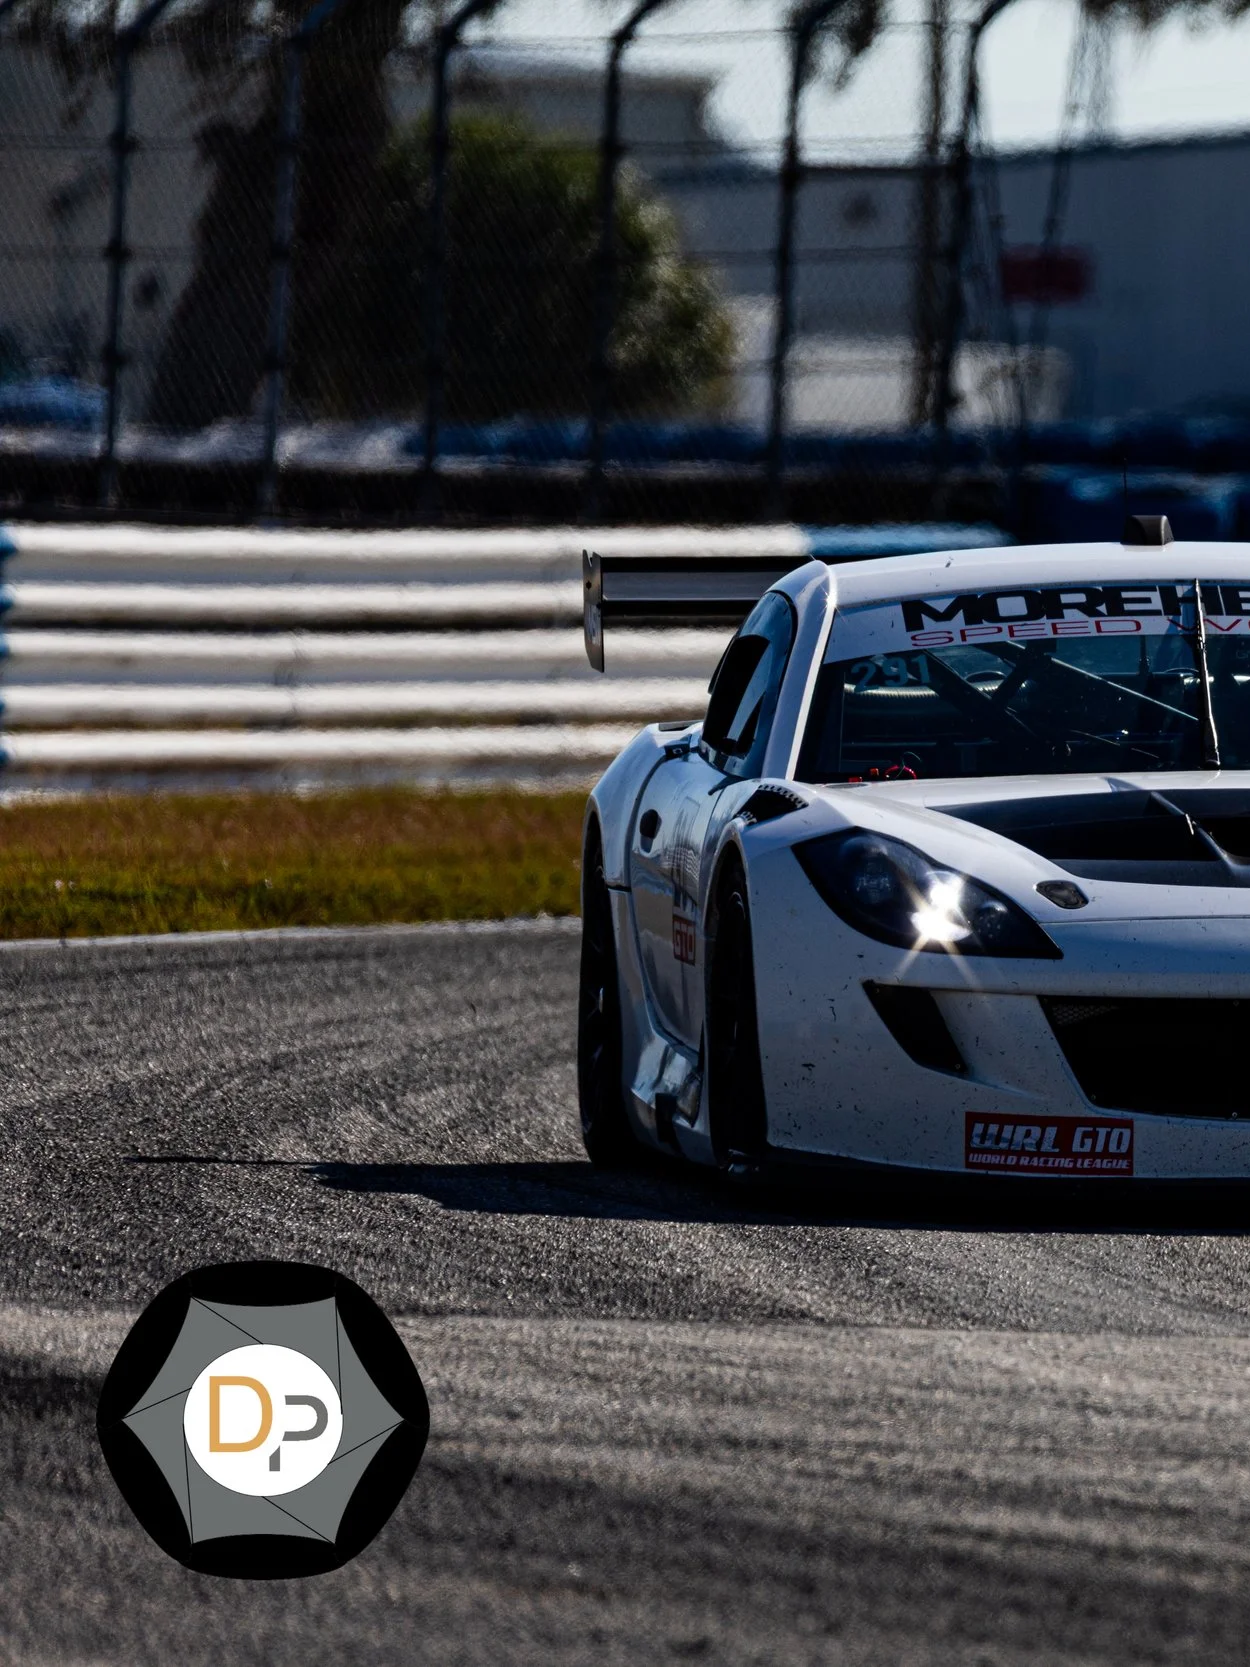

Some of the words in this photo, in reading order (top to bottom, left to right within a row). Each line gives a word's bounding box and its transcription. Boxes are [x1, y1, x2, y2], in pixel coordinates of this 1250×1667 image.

[911, 618, 1142, 647] SPEED
[851, 654, 931, 693] 291
[969, 1121, 1060, 1153] WRL
[1072, 1126, 1132, 1154] GTO
[968, 1152, 1017, 1166] WORLD
[1019, 1155, 1075, 1169] RACING
[1076, 1158, 1132, 1170] LEAGUE
